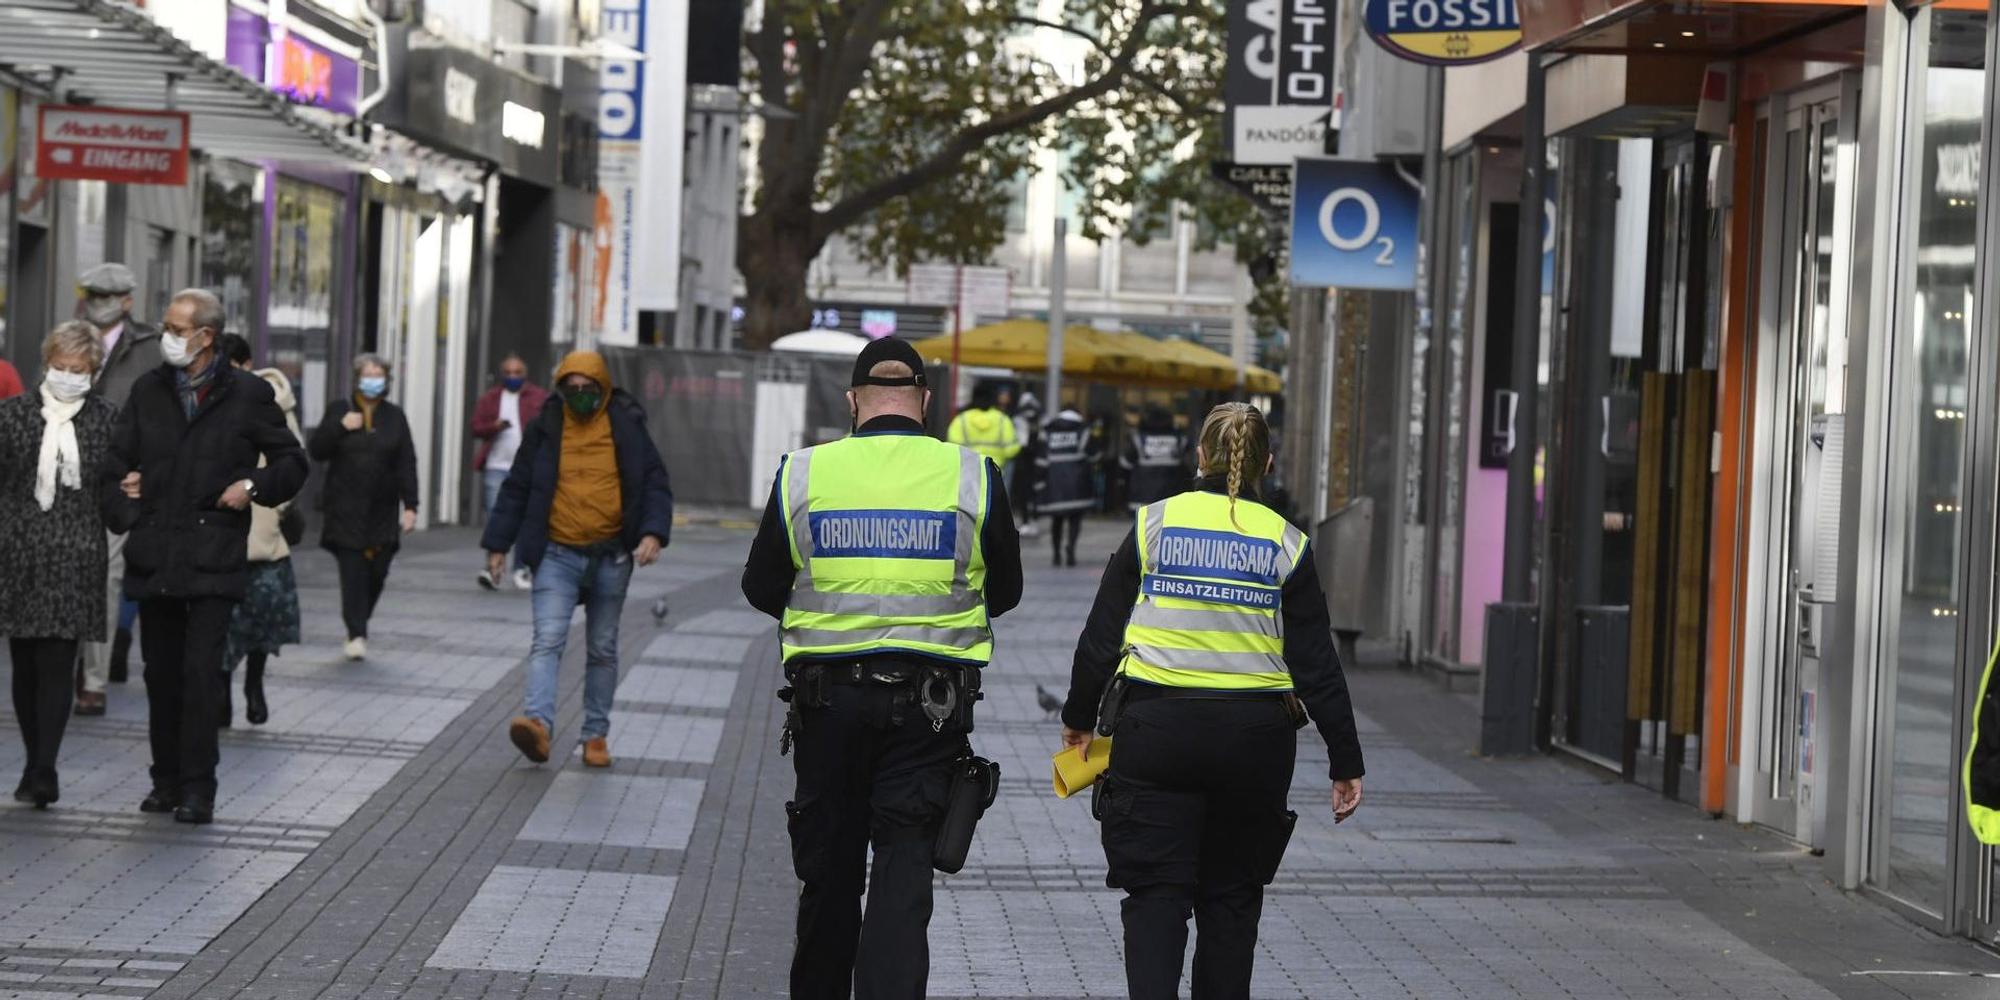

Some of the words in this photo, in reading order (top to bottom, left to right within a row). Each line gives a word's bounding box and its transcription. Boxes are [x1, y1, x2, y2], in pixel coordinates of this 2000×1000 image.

[599, 0, 638, 137] ODE
[82, 149, 172, 172] EINGANG
[1318, 187, 1394, 265] O2
[820, 517, 943, 551] ORDNUNGSAMT
[1152, 580, 1274, 605] EINSATZLEITUNG
